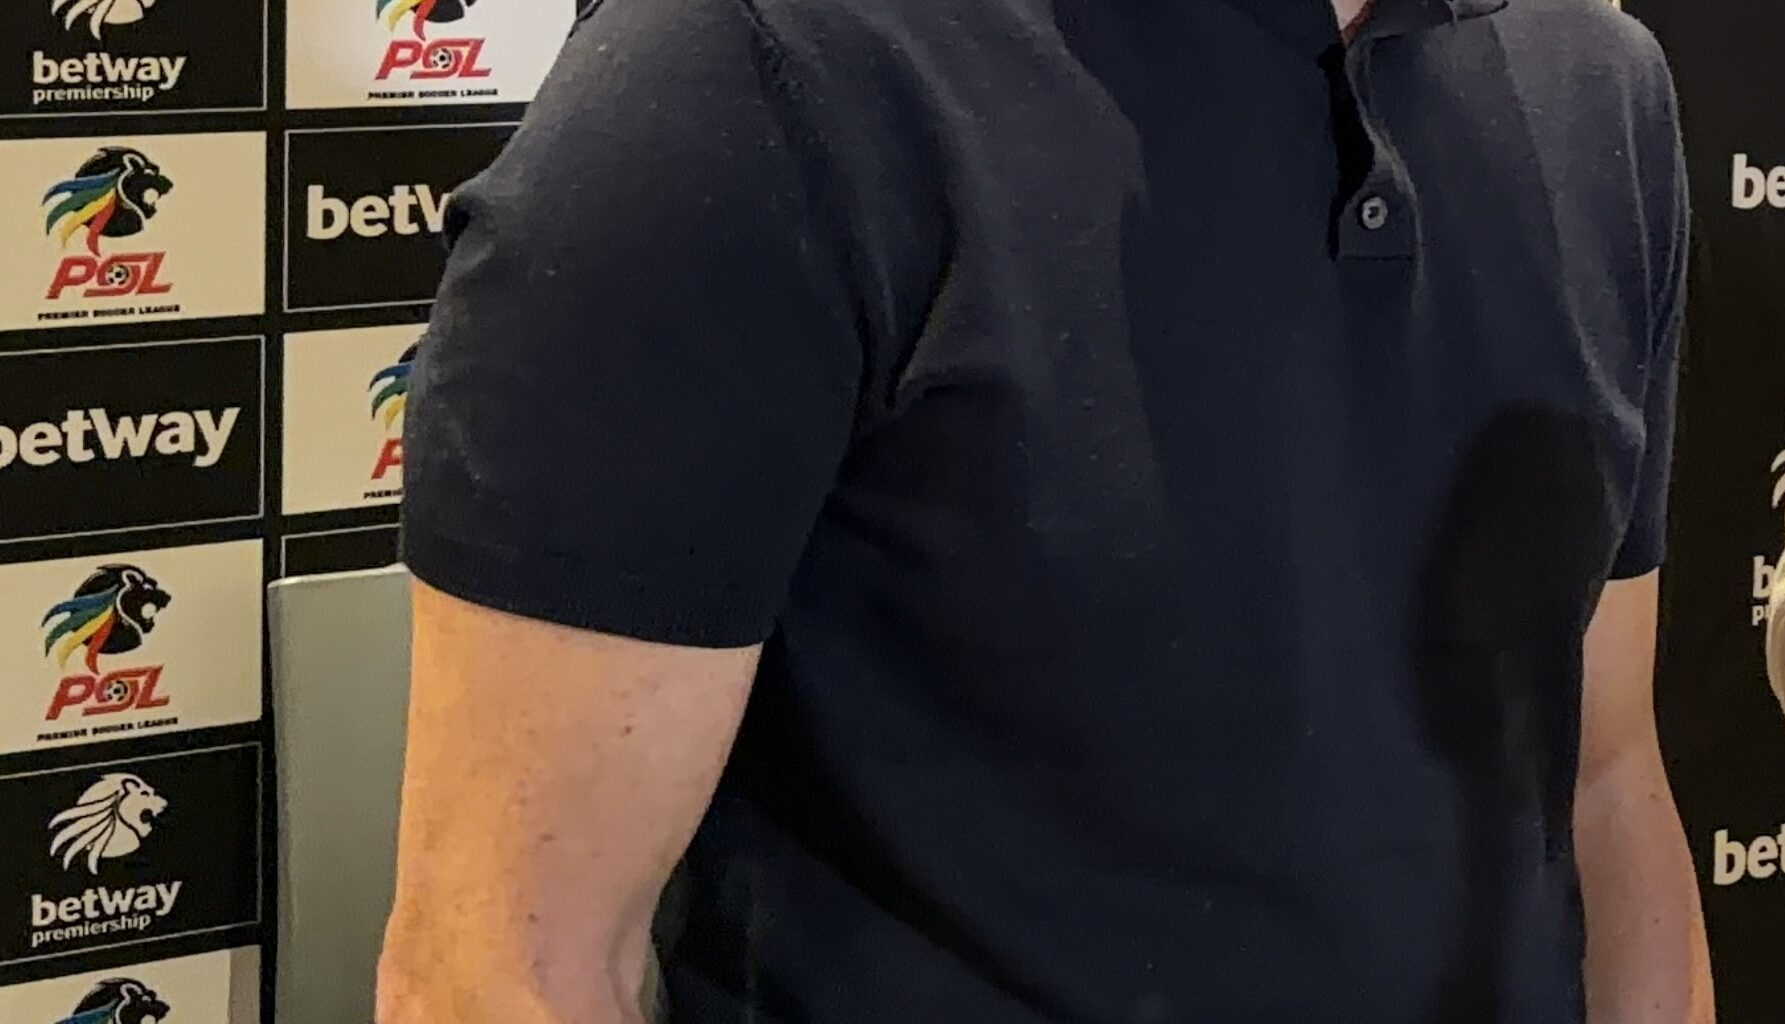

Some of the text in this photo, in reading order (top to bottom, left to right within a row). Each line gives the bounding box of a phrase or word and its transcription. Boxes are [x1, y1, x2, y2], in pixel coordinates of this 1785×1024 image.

[33, 51, 187, 91] betway
[375, 38, 492, 80] PSL
[33, 83, 155, 104] premiership
[46, 251, 174, 299] PSL
[46, 665, 170, 720] PSL
[31, 879, 182, 927] betway
[31, 913, 151, 947] premiership
